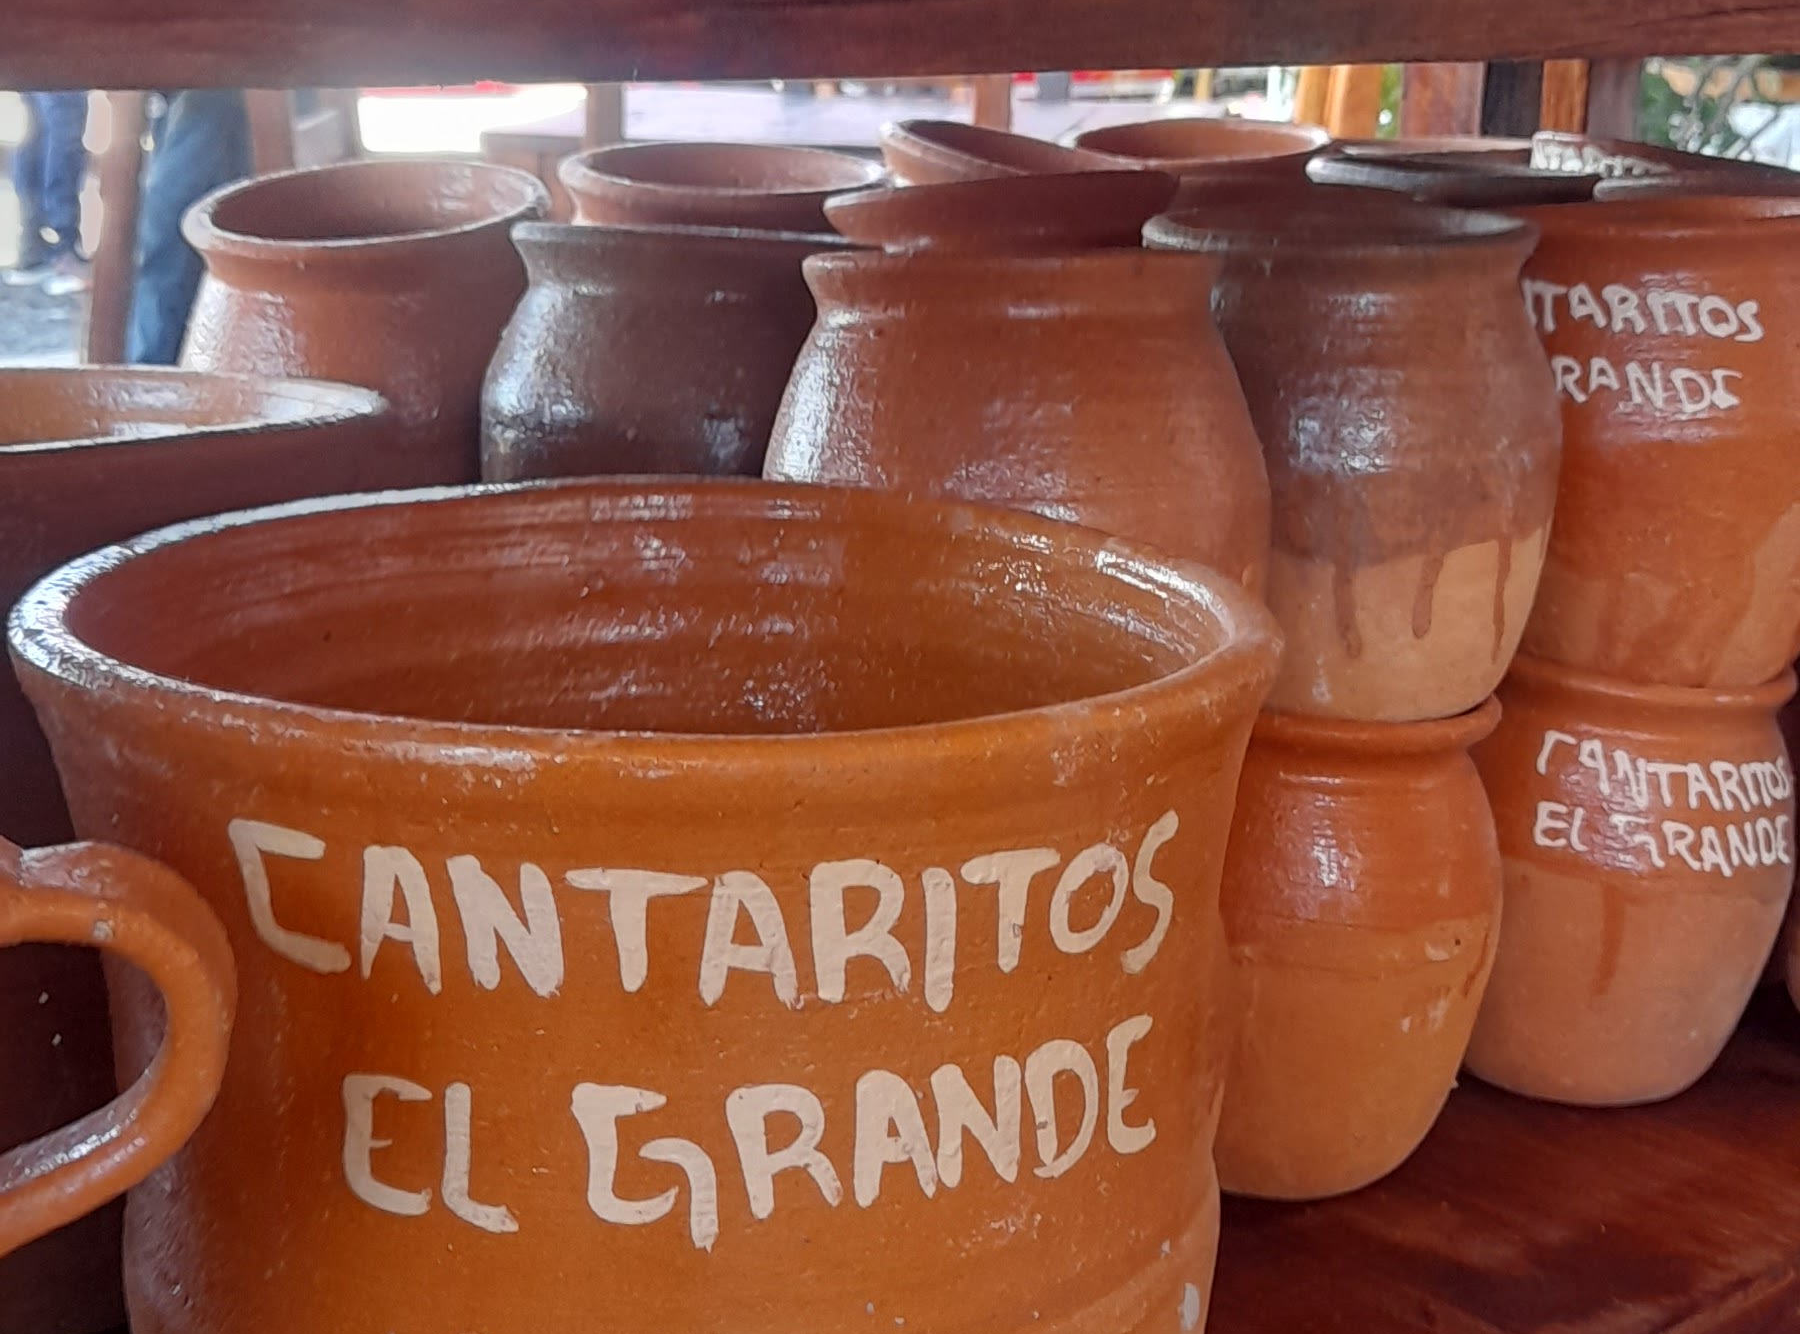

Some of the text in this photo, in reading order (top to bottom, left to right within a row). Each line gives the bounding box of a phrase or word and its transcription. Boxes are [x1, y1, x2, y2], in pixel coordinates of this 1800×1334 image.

[228, 810, 1180, 1012] CANTARITOS
[1533, 800, 1791, 877] EL GRANDE
[342, 1015, 1158, 1253] EL GRANDE
